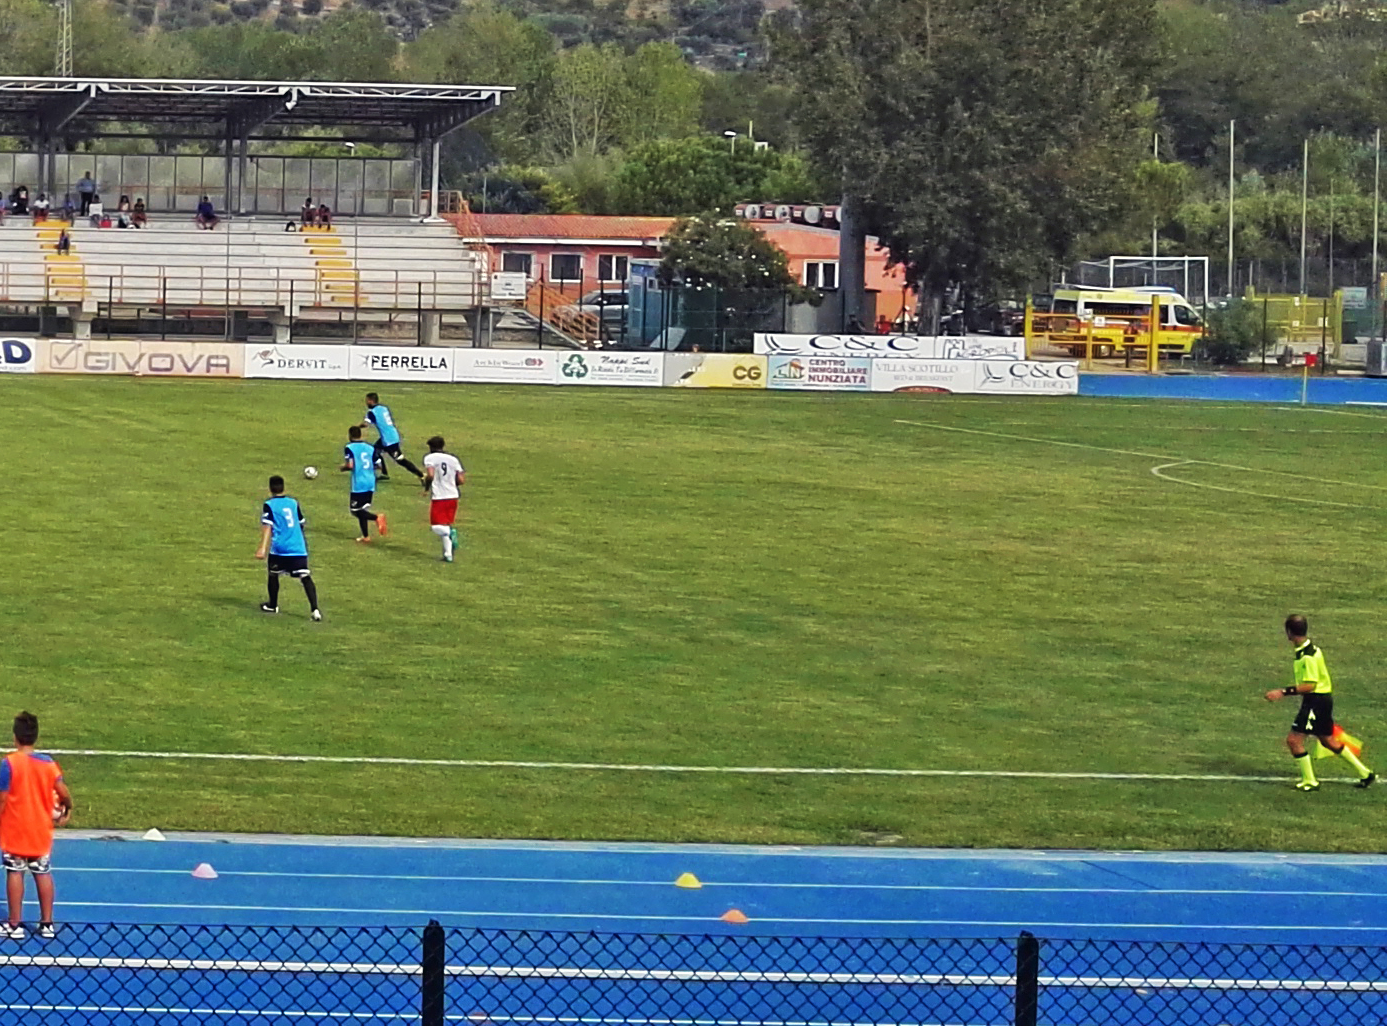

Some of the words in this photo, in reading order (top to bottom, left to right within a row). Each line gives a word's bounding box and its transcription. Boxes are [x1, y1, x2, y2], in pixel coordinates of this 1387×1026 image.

[809, 335, 920, 352] C&C
[2, 340, 32, 364] D
[83, 352, 230, 374] GIVOVA
[277, 358, 327, 369] DERVIT
[371, 355, 448, 369] PERRELLA
[808, 366, 868, 374] IMMOBILIARE
[875, 364, 906, 372] VILLA
[733, 365, 762, 381] CG
[808, 375, 866, 383] NUNZIATA
[1009, 363, 1077, 379] C&C
[360, 452, 371, 469] 5
[441, 462, 447, 476] 9
[282, 507, 295, 528] 3
